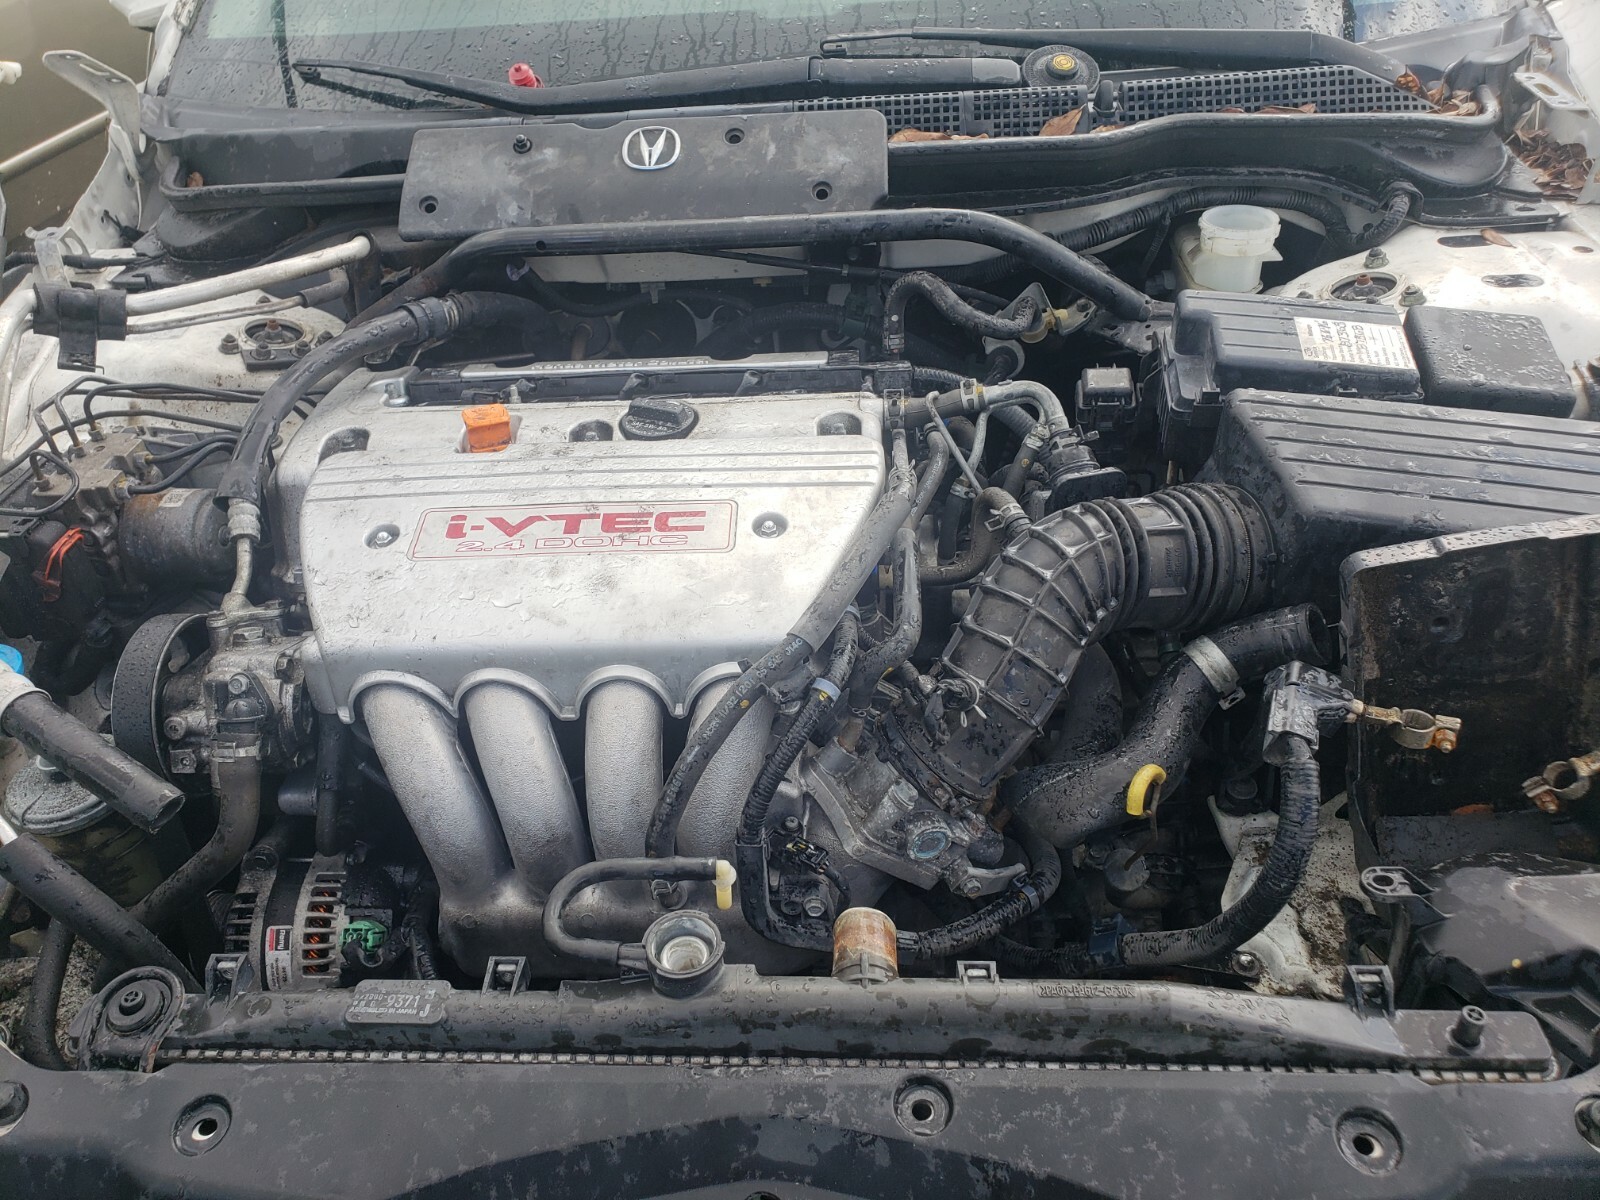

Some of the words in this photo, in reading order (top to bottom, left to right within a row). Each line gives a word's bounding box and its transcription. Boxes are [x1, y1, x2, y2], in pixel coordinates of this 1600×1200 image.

[445, 510, 707, 540] i-VTEC
[455, 539, 526, 553] 2.4
[534, 534, 689, 549] DOHC
[767, 654, 784, 669] SAE
[277, 929, 285, 950] Remy
